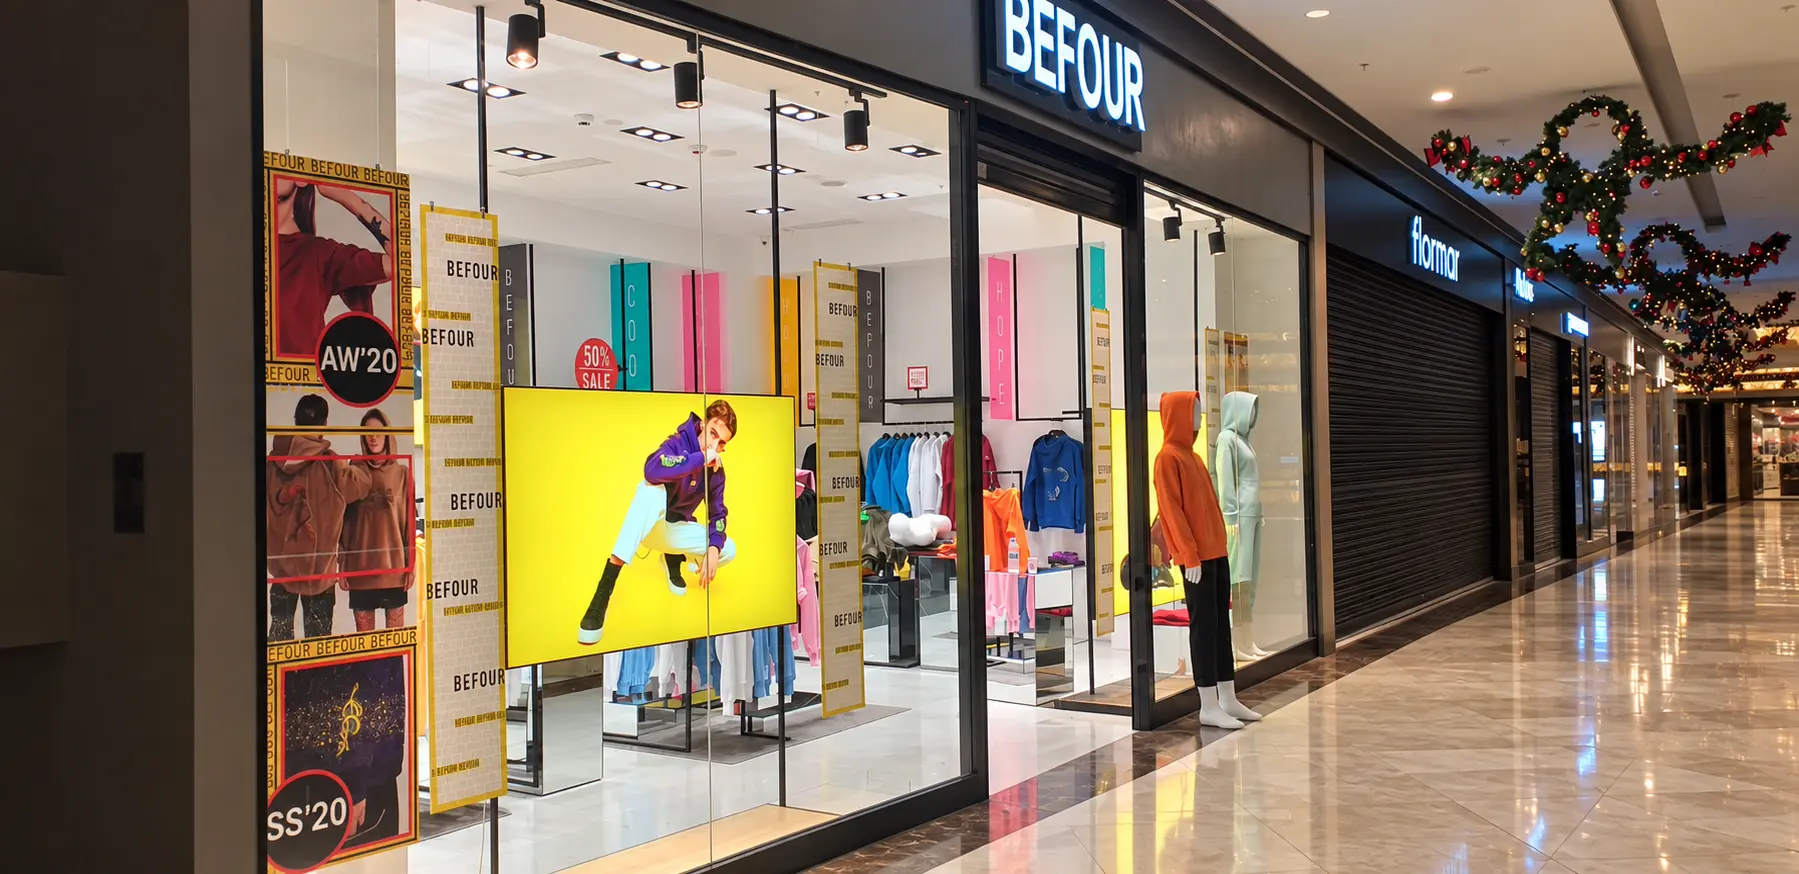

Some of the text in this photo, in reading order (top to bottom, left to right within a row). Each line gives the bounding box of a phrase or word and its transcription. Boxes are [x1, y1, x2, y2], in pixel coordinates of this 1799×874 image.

[1004, 0, 1146, 132] BEFOUR
[311, 158, 359, 179] BEFOUR
[364, 167, 409, 187] BEFOUR
[1411, 214, 1460, 282] flormar
[447, 259, 499, 281] BEFOUR
[828, 302, 858, 318] BEFOUR
[422, 328, 475, 348] BEFOUR
[996, 281, 1005, 405] HOPE
[320, 345, 397, 374] AW'20
[583, 345, 610, 367] 50%
[815, 353, 845, 368] BEFOUR
[582, 372, 611, 389] SALE
[832, 475, 860, 490] BEFOUR
[451, 491, 502, 511] BEFOUR
[819, 541, 848, 556] BEFOUR
[426, 578, 479, 600] BEFOUR
[835, 611, 862, 628] BEFOUR
[316, 637, 366, 655] BEFOUR
[371, 631, 417, 648] BEFOUR
[454, 668, 505, 692] BEFOUR
[267, 796, 347, 841] SS'20
